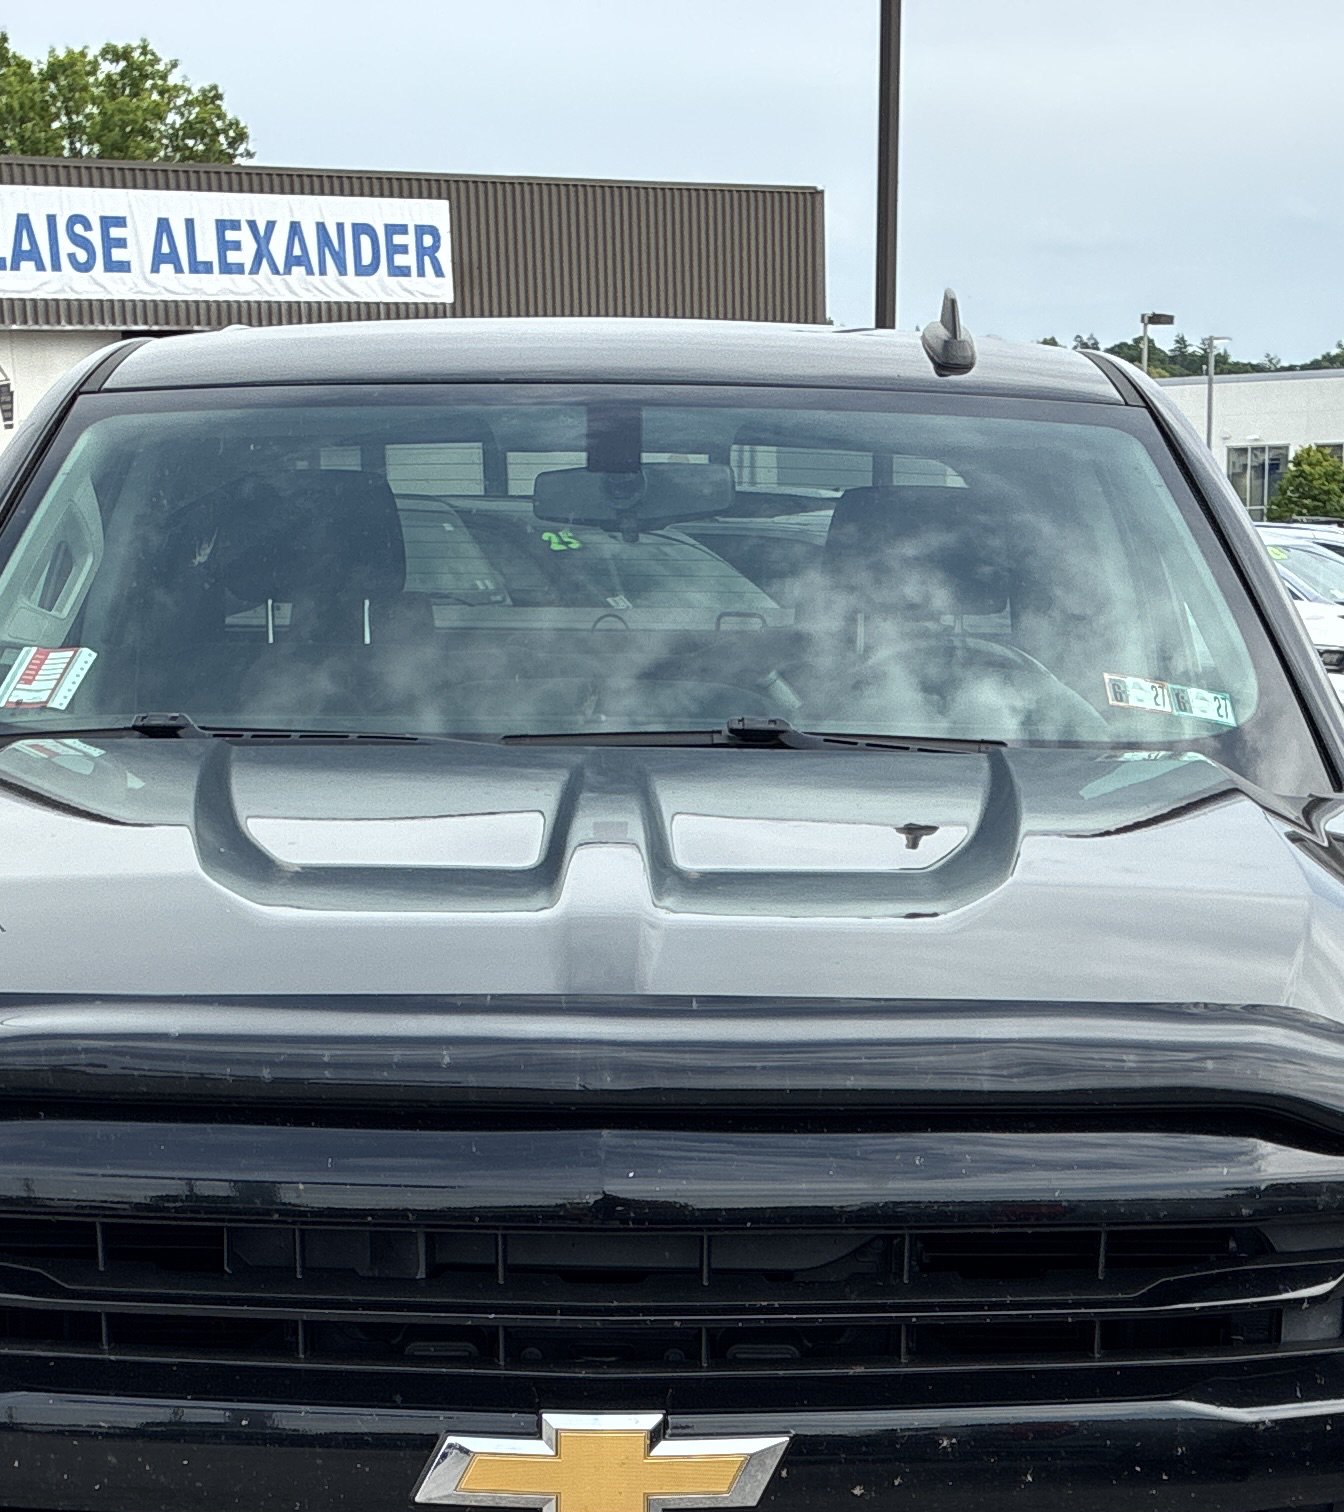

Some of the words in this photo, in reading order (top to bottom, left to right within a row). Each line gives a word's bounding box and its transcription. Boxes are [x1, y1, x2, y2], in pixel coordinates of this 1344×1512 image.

[150, 216, 446, 279] ALEXANDER
[542, 531, 581, 551] 25
[1150, 683, 1167, 709] 27
[1213, 694, 1230, 719] 27
